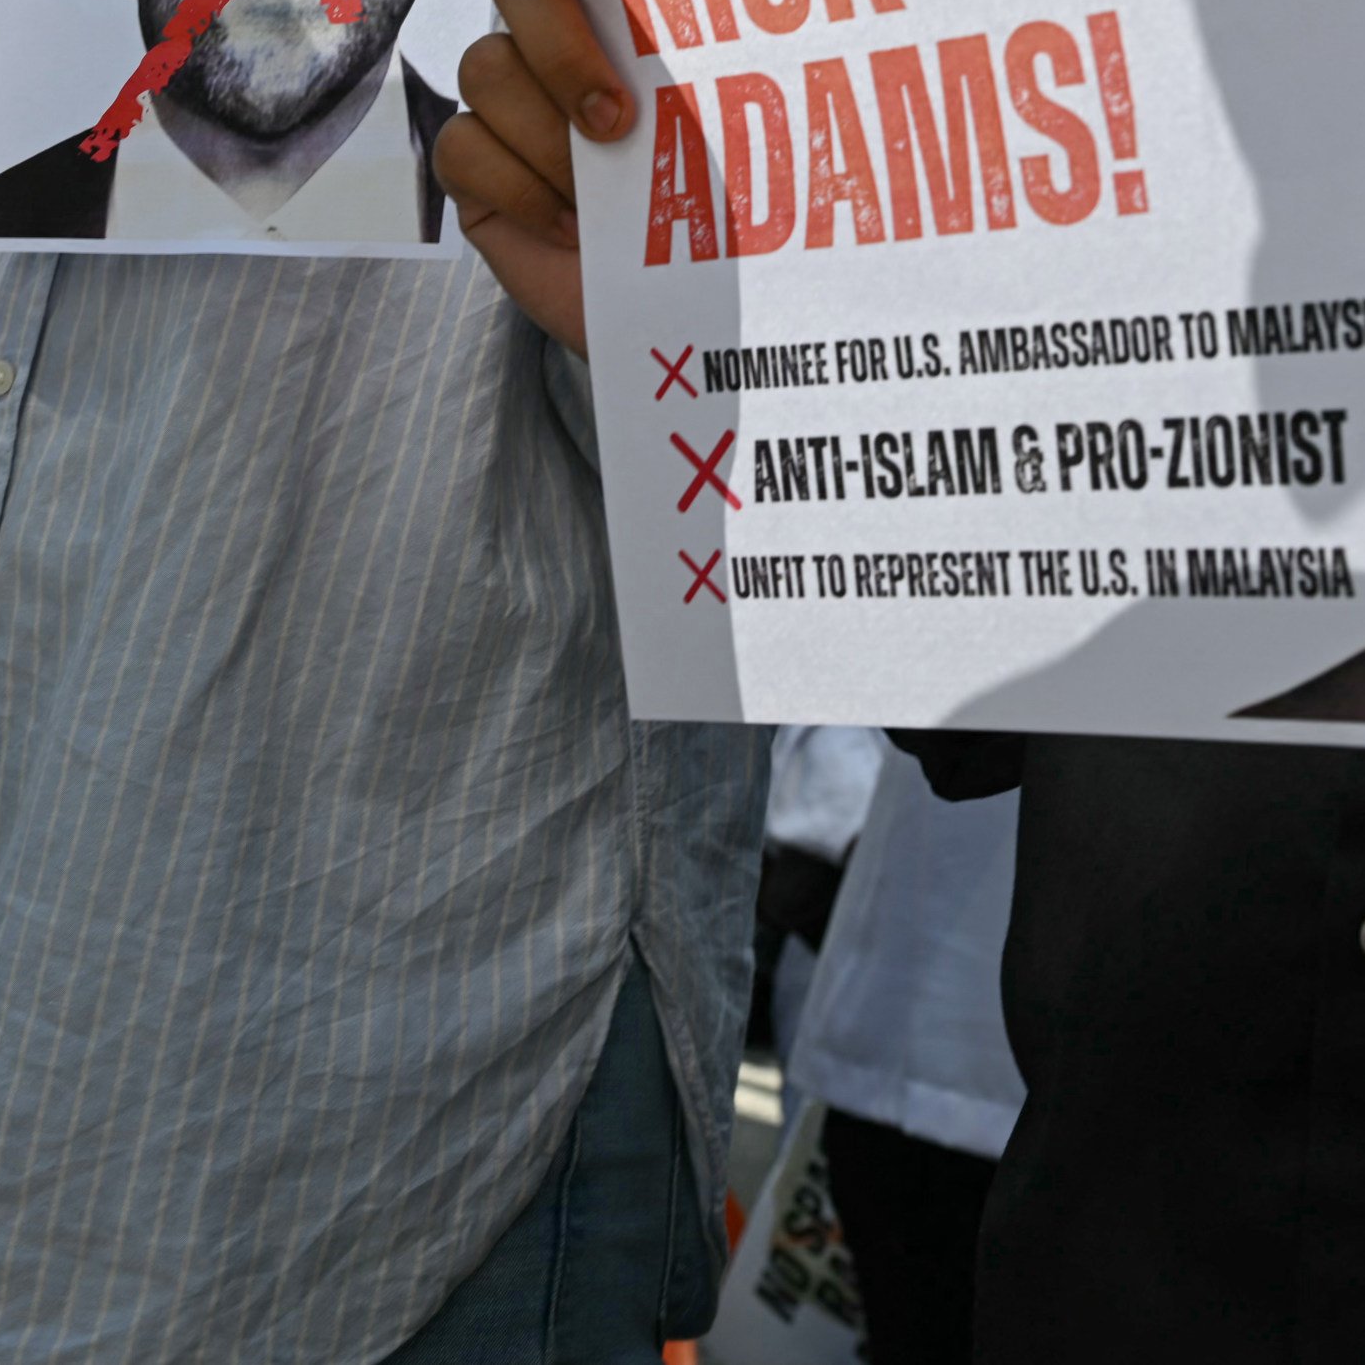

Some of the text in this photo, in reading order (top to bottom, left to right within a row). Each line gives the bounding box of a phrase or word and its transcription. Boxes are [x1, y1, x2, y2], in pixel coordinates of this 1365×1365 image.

[643, 10, 1150, 267] ADAMS!
[703, 341, 830, 394] NOMINEE
[834, 337, 889, 385] FOR
[893, 333, 952, 380] U.S.
[959, 315, 1174, 376] AMBASSADOR
[1179, 311, 1219, 360] TO
[754, 408, 1348, 504] ANTI-ISLAM & PRO-ZIONIST
[731, 546, 1355, 599] UNFIT TO REPRESENT THE U.S. IN MALAYSIA
